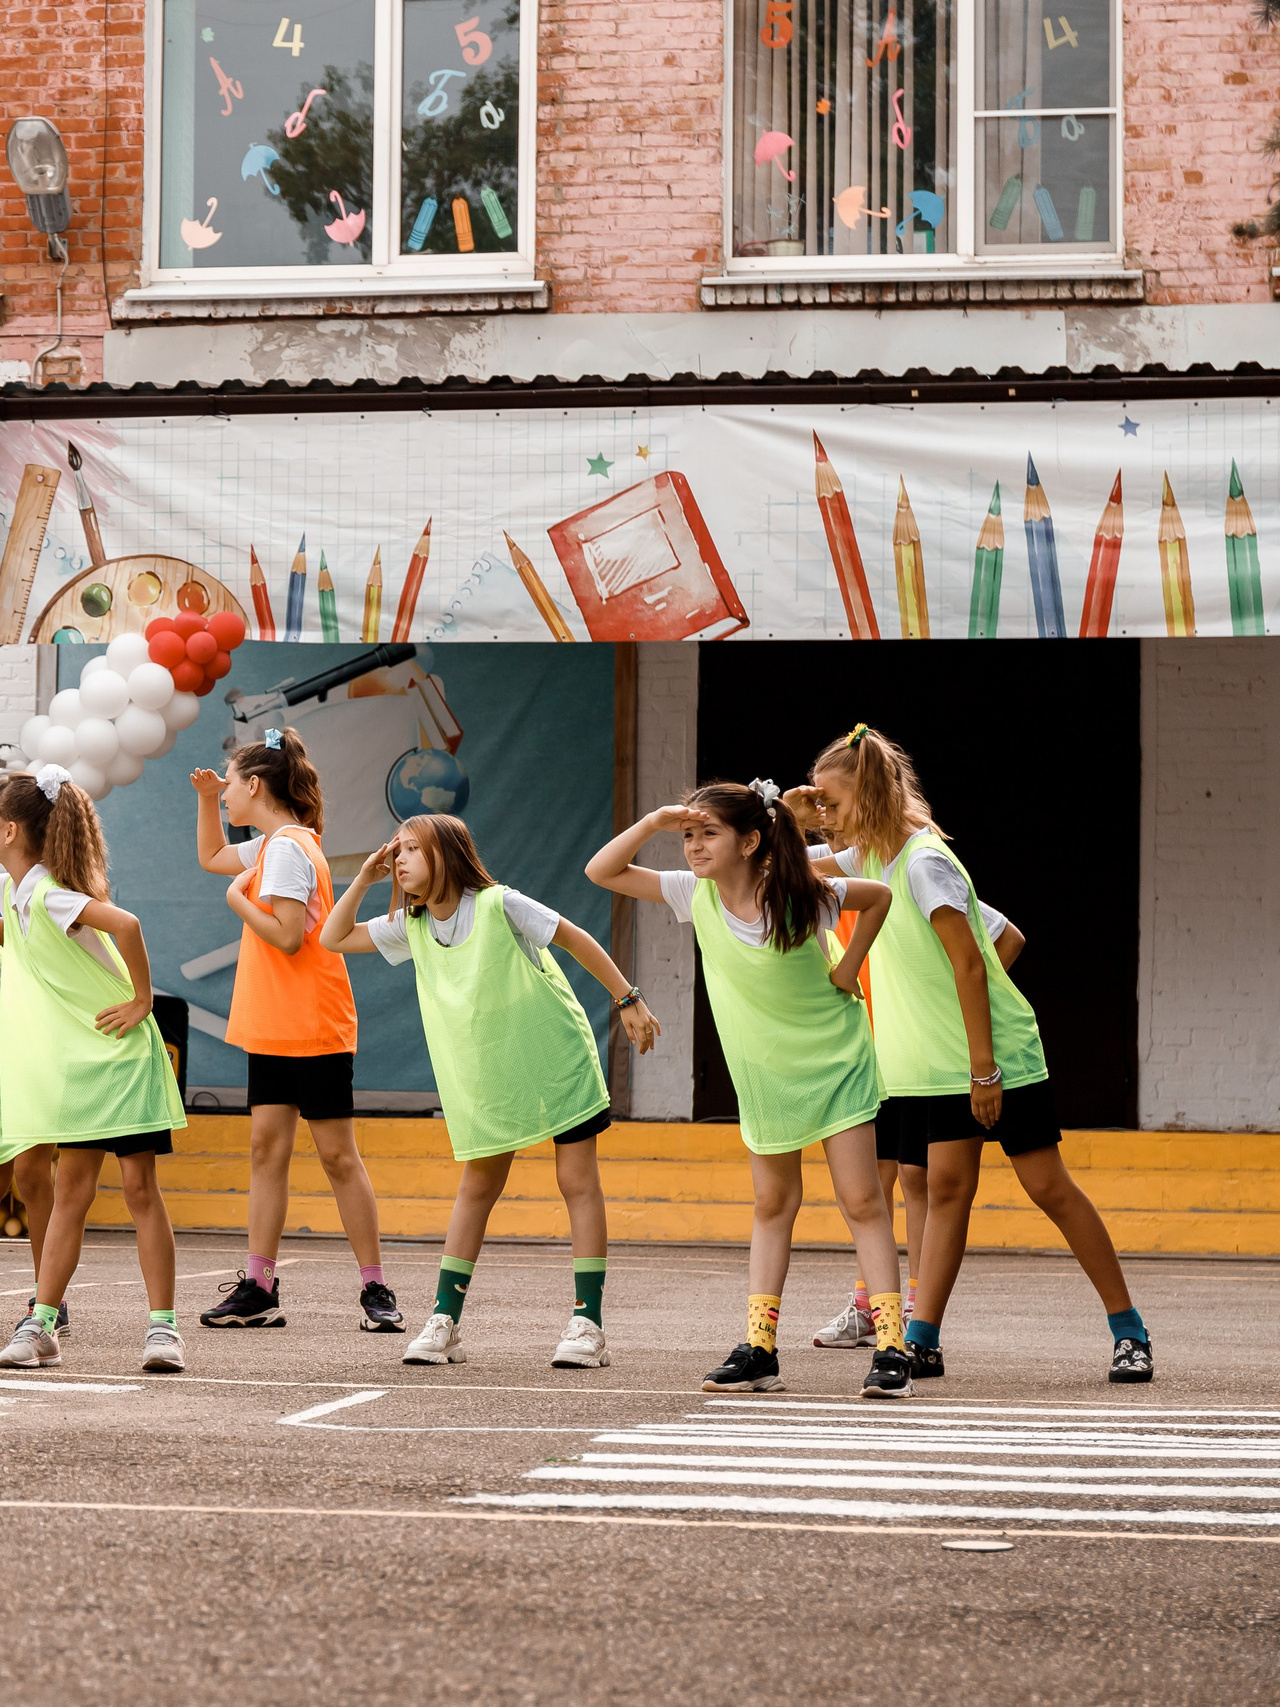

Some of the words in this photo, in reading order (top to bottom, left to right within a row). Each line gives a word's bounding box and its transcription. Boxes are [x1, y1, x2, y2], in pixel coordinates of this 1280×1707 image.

[272, 17, 305, 57] 4
[453, 16, 493, 66] 5
[761, 0, 796, 49] 5
[1043, 15, 1079, 50] 4
